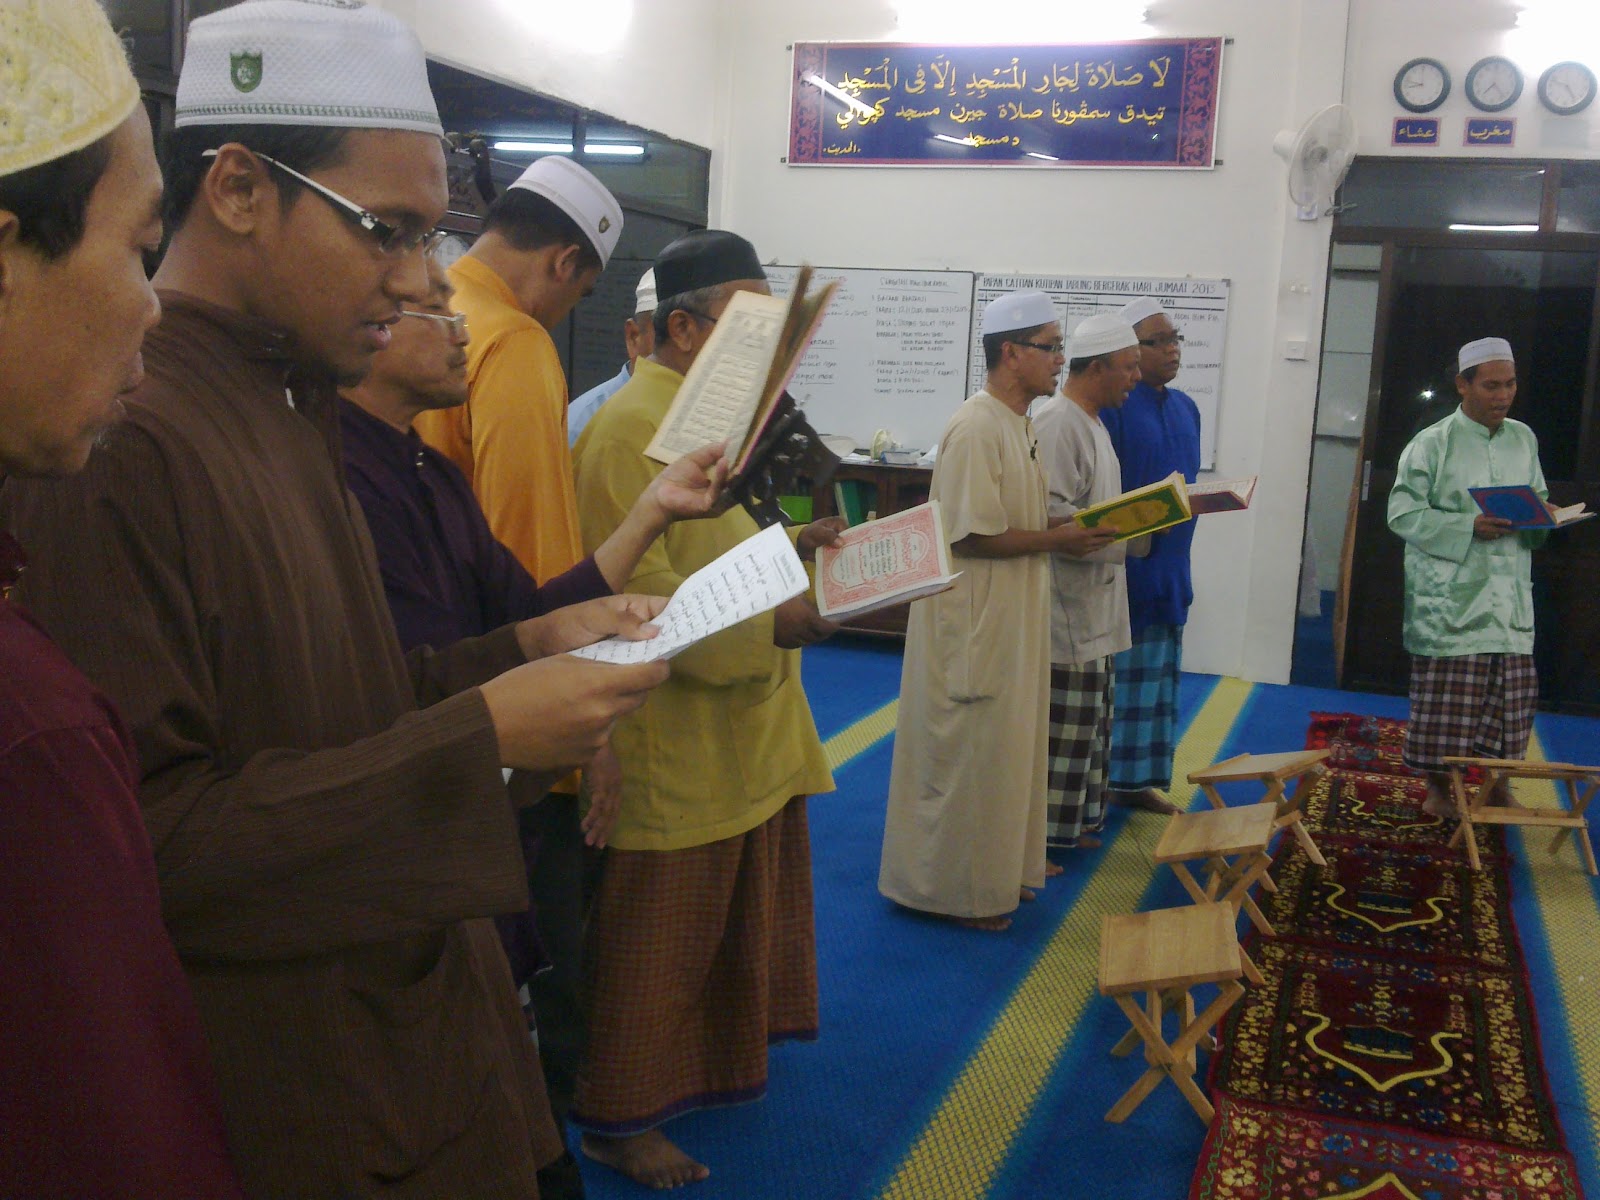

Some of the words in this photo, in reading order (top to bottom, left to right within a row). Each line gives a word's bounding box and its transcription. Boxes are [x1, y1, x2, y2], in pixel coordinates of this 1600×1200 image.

[895, 105, 940, 121] مسجد
[950, 103, 987, 123] جيرن
[998, 101, 1043, 121] صلاة
[1118, 104, 1166, 126] تيدق
[1398, 125, 1436, 138] عشاء
[1470, 125, 1511, 140] مغرب
[983, 277, 1003, 288] PAPAN
[1035, 279, 1063, 290] KUTIPAN
[1065, 280, 1092, 291] TABUNG
[1093, 280, 1130, 293] BERGERAK
[1132, 281, 1152, 293] HARI
[1154, 281, 1188, 294] JUMAAT
[1192, 283, 1216, 294] 2013
